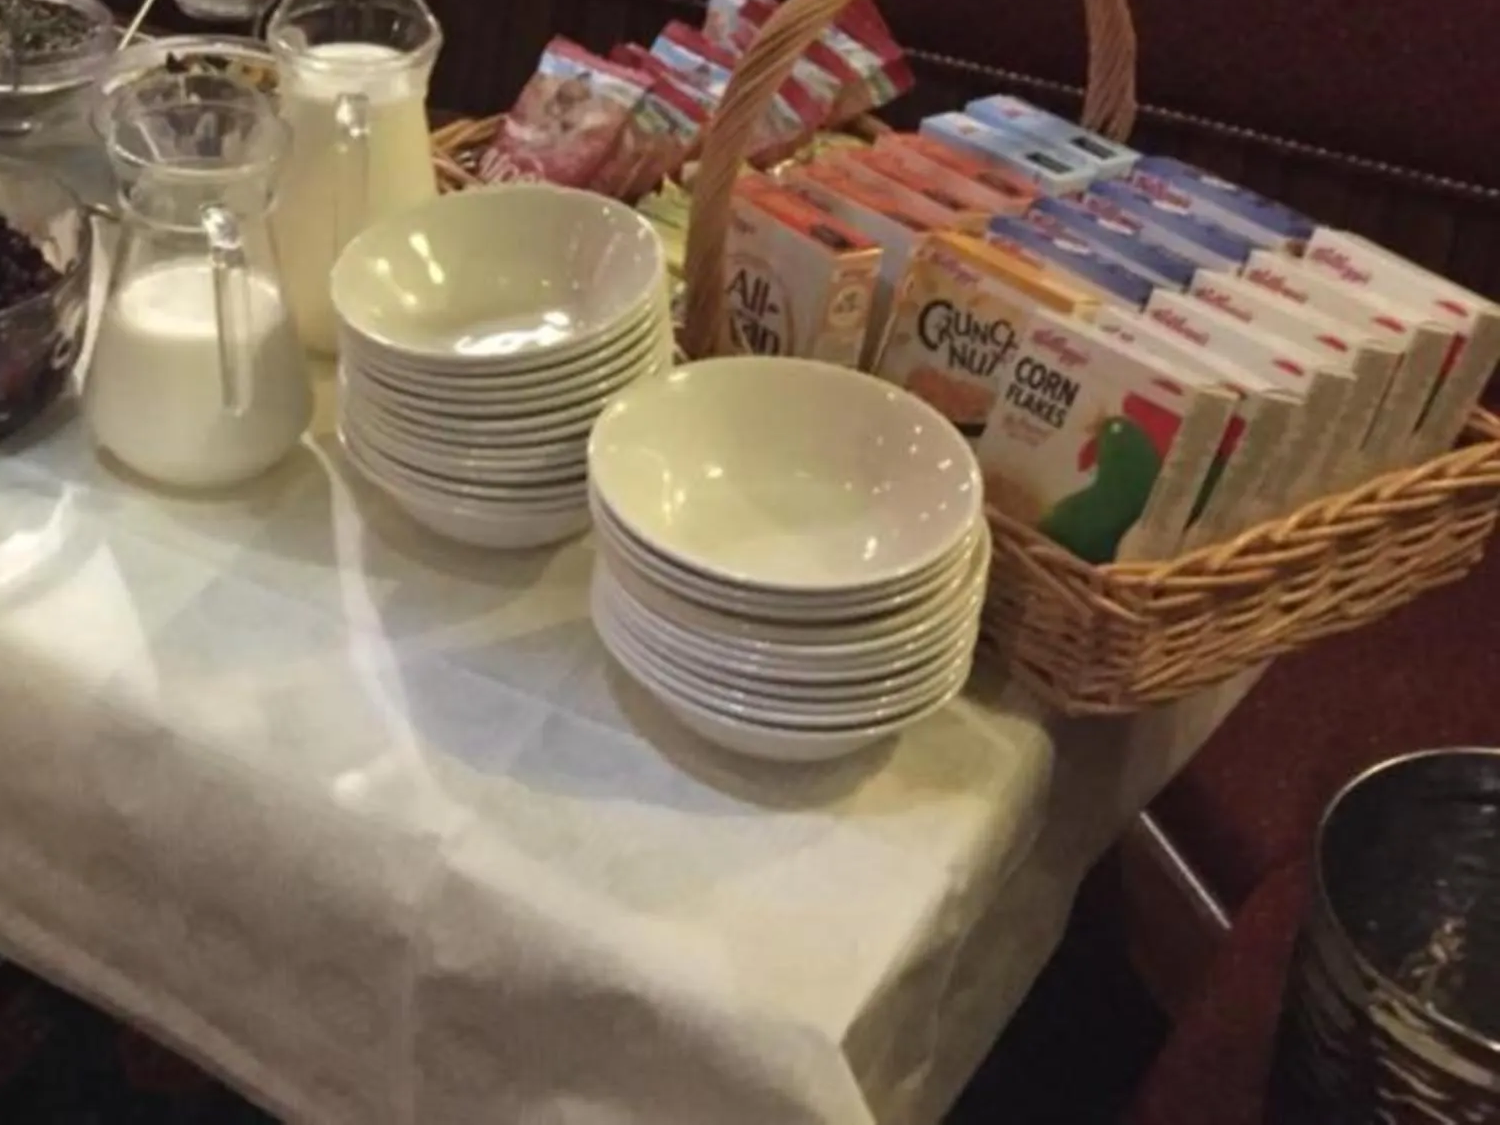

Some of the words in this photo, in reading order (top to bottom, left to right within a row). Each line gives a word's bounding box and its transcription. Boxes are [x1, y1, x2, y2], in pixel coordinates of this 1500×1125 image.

[724, 268, 781, 317] All-
[1005, 382, 1067, 430] FLAKES
[1015, 355, 1081, 408] CORN
